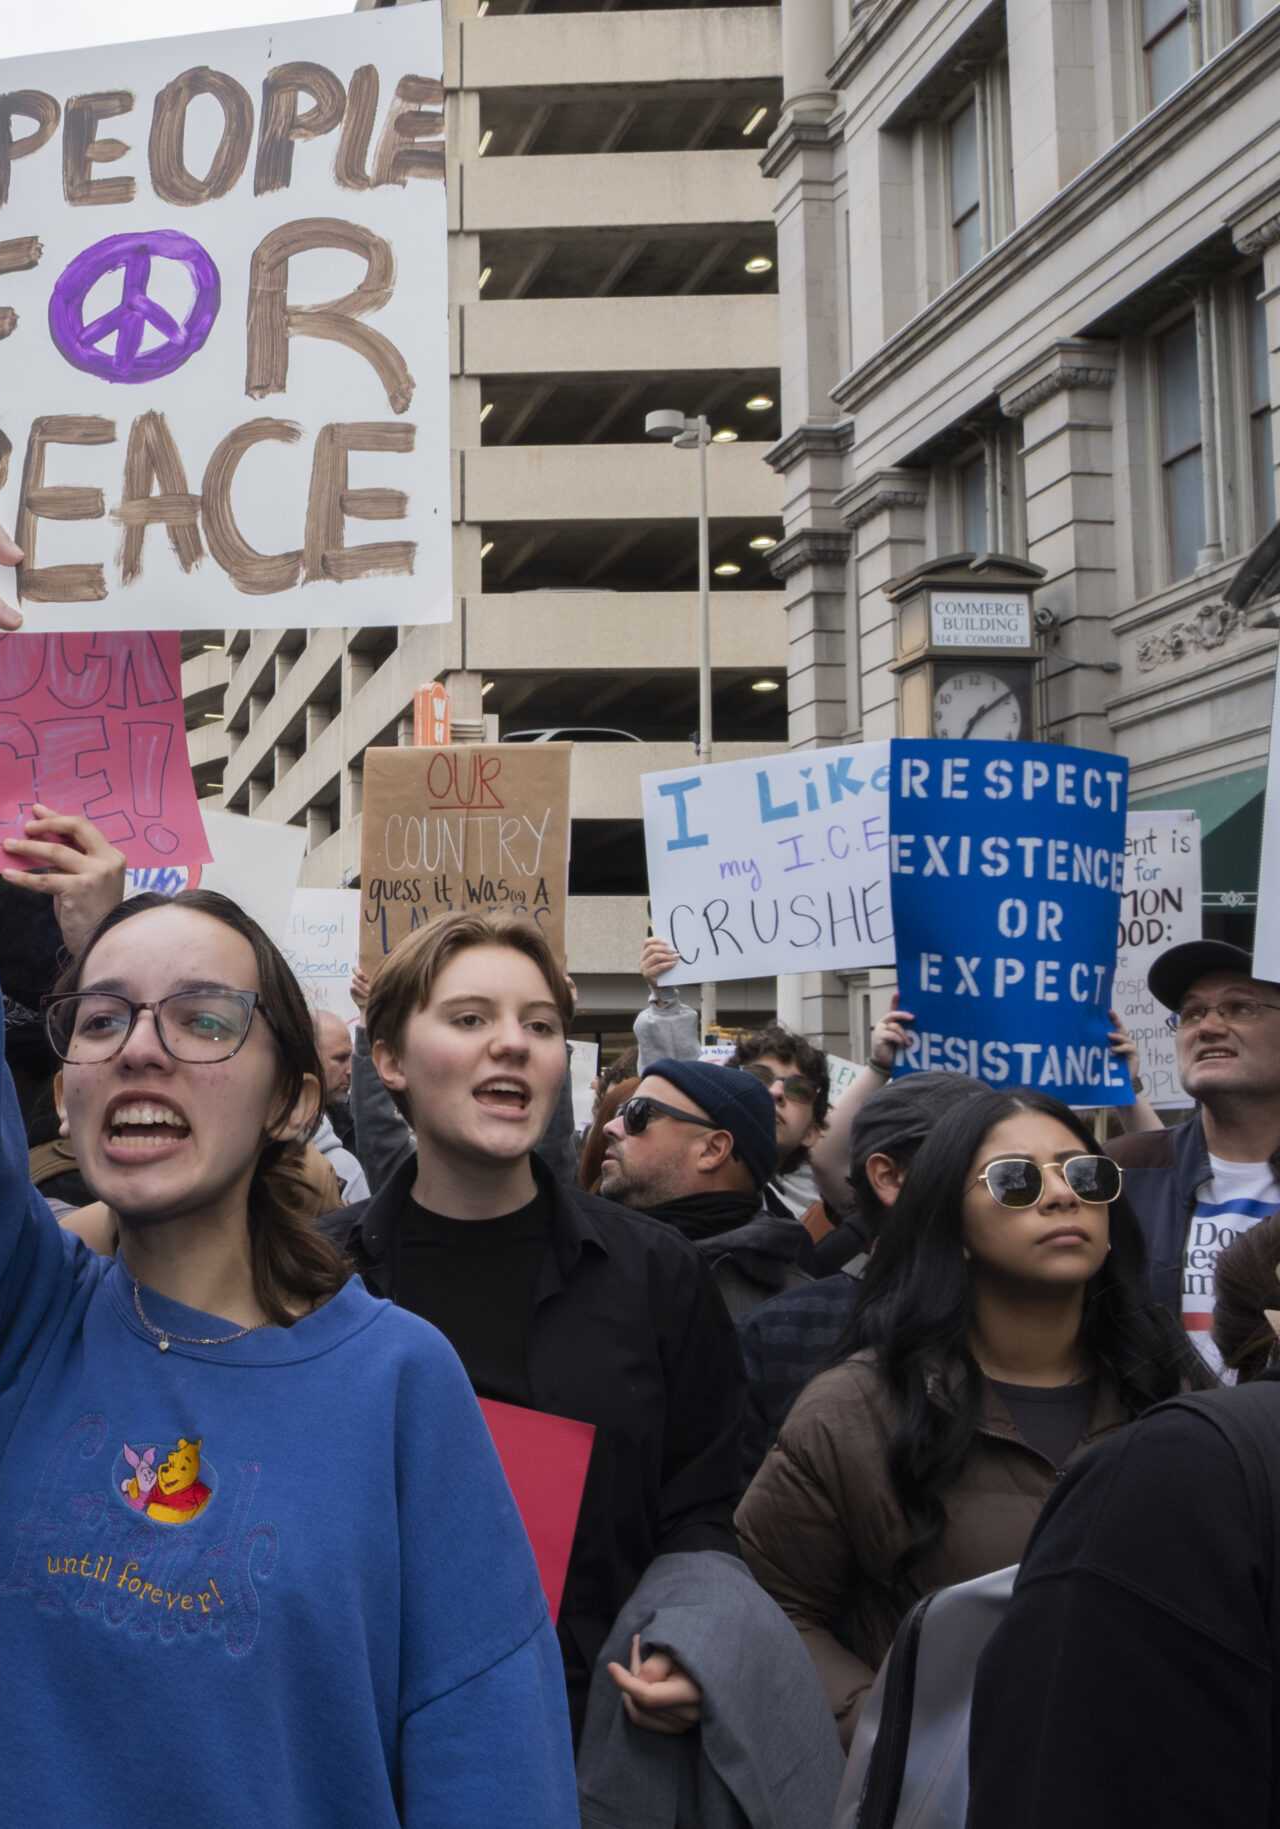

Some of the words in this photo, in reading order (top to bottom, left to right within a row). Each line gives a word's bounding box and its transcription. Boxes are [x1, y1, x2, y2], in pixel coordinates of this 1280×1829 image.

[934, 601, 1025, 616] COMMERCE
[942, 617, 1019, 632] BUILDING
[939, 693, 952, 705] 10
[953, 679, 964, 690] 11
[970, 675, 981, 686] 12
[427, 752, 505, 808] OUR
[900, 758, 1123, 813] RESPECT
[658, 776, 709, 851] I
[385, 807, 551, 877] COUNTRY
[1171, 829, 1192, 853] is
[719, 858, 762, 892] my
[890, 834, 1125, 893] EXISTENCE
[1133, 858, 1163, 883] for
[365, 877, 422, 923] guess
[434, 873, 453, 903] it
[533, 877, 550, 905] A
[670, 880, 895, 965] CRUSHE
[997, 898, 1064, 942] OR
[920, 952, 1106, 1005] EXPECT
[1124, 1000, 1155, 1016] and
[894, 1028, 1125, 1087] RESISTANCE
[1147, 1049, 1174, 1065] the
[1194, 1222, 1241, 1250] Do
[46, 1552, 114, 1584] until
[117, 1560, 225, 1614] forever!
